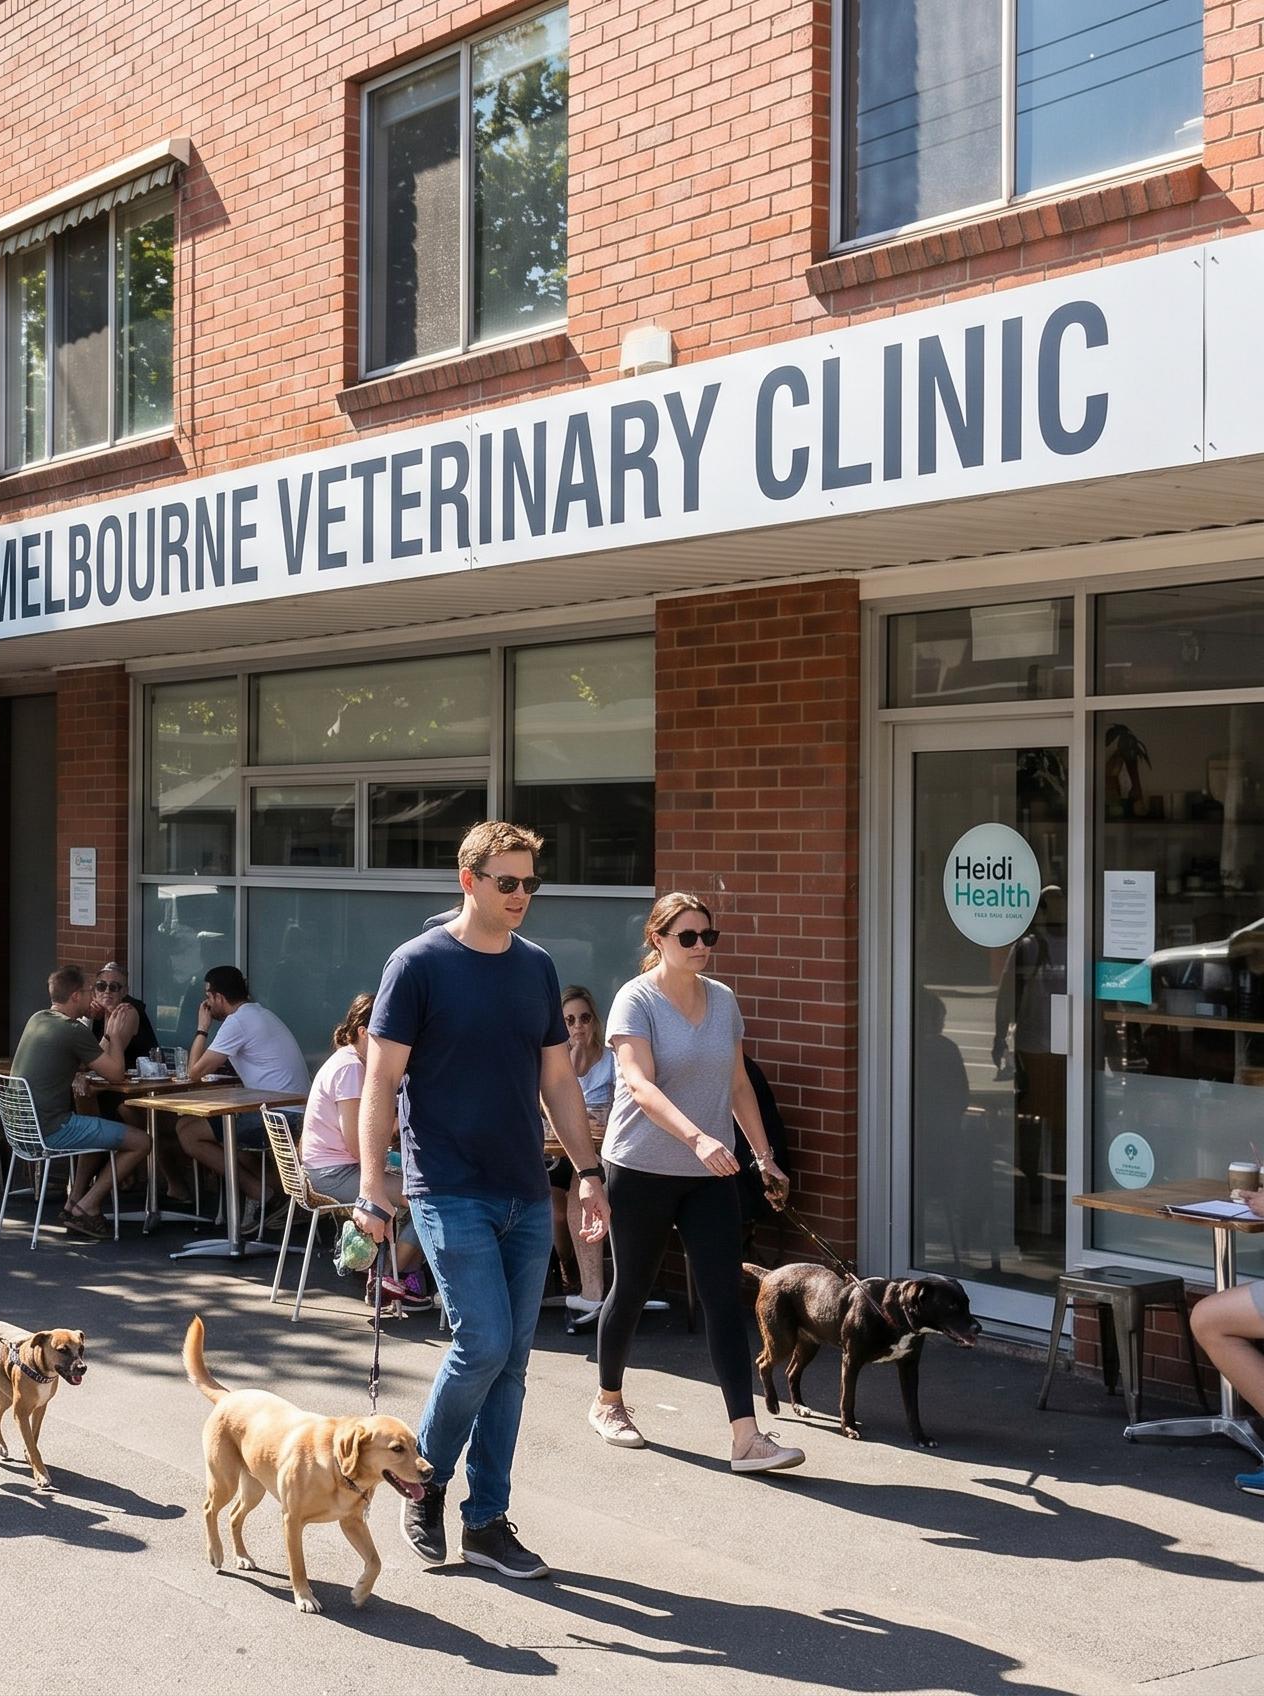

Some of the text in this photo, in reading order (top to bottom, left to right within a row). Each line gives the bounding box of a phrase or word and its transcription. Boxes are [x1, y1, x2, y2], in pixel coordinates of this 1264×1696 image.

[278, 382, 722, 577] VETERINARY
[755, 300, 1110, 501] CLINIC
[955, 855, 1012, 880] Heidi
[955, 882, 1030, 907] Health
